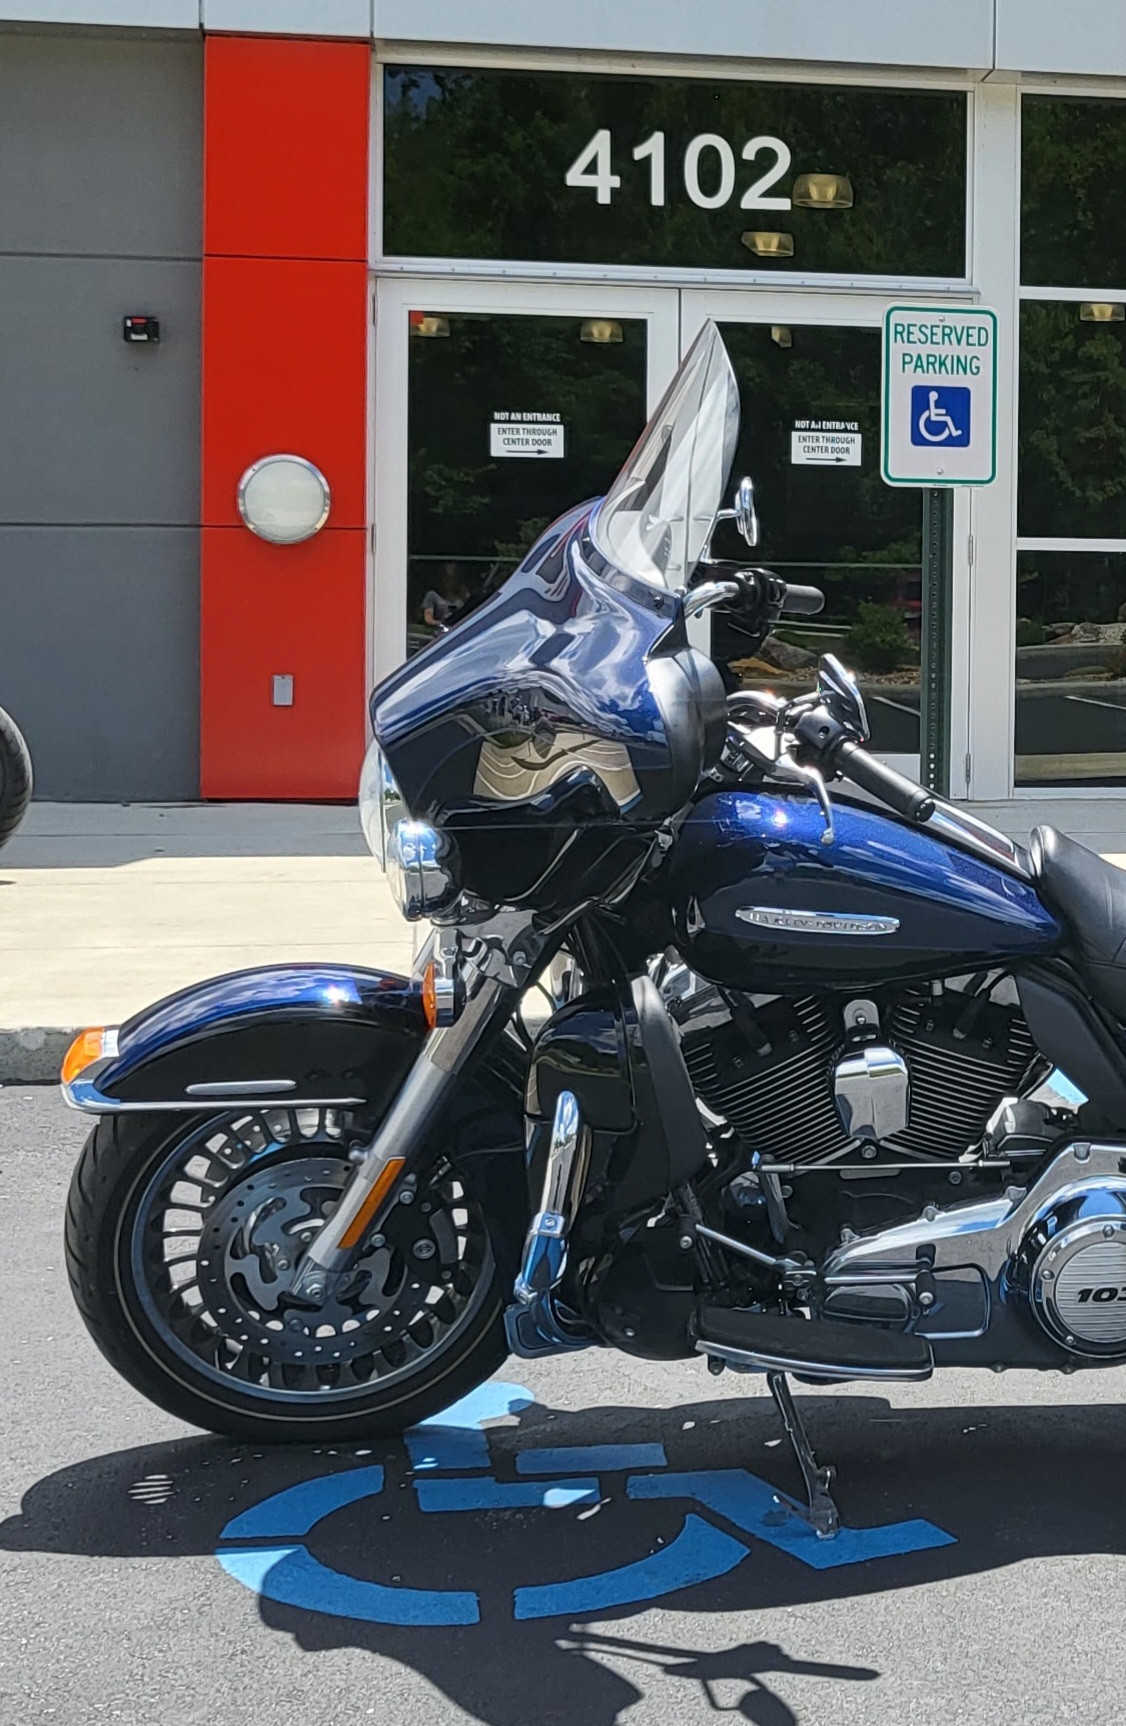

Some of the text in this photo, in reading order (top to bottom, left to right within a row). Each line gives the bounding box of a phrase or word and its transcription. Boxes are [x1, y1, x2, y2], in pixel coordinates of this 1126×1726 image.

[565, 129, 792, 211] 4102
[893, 322, 989, 347] RESERVED
[901, 352, 981, 376] PARKING
[493, 411, 561, 422] NOT AN ENTRANCE
[794, 419, 859, 431] NOT AN ENTRANCE
[497, 427, 558, 437] ENTER THROUGH
[502, 437, 553, 447] CENTER DOOR
[797, 435, 856, 445] ENTER THROUGH
[802, 445, 851, 455] CENTER DOOR
